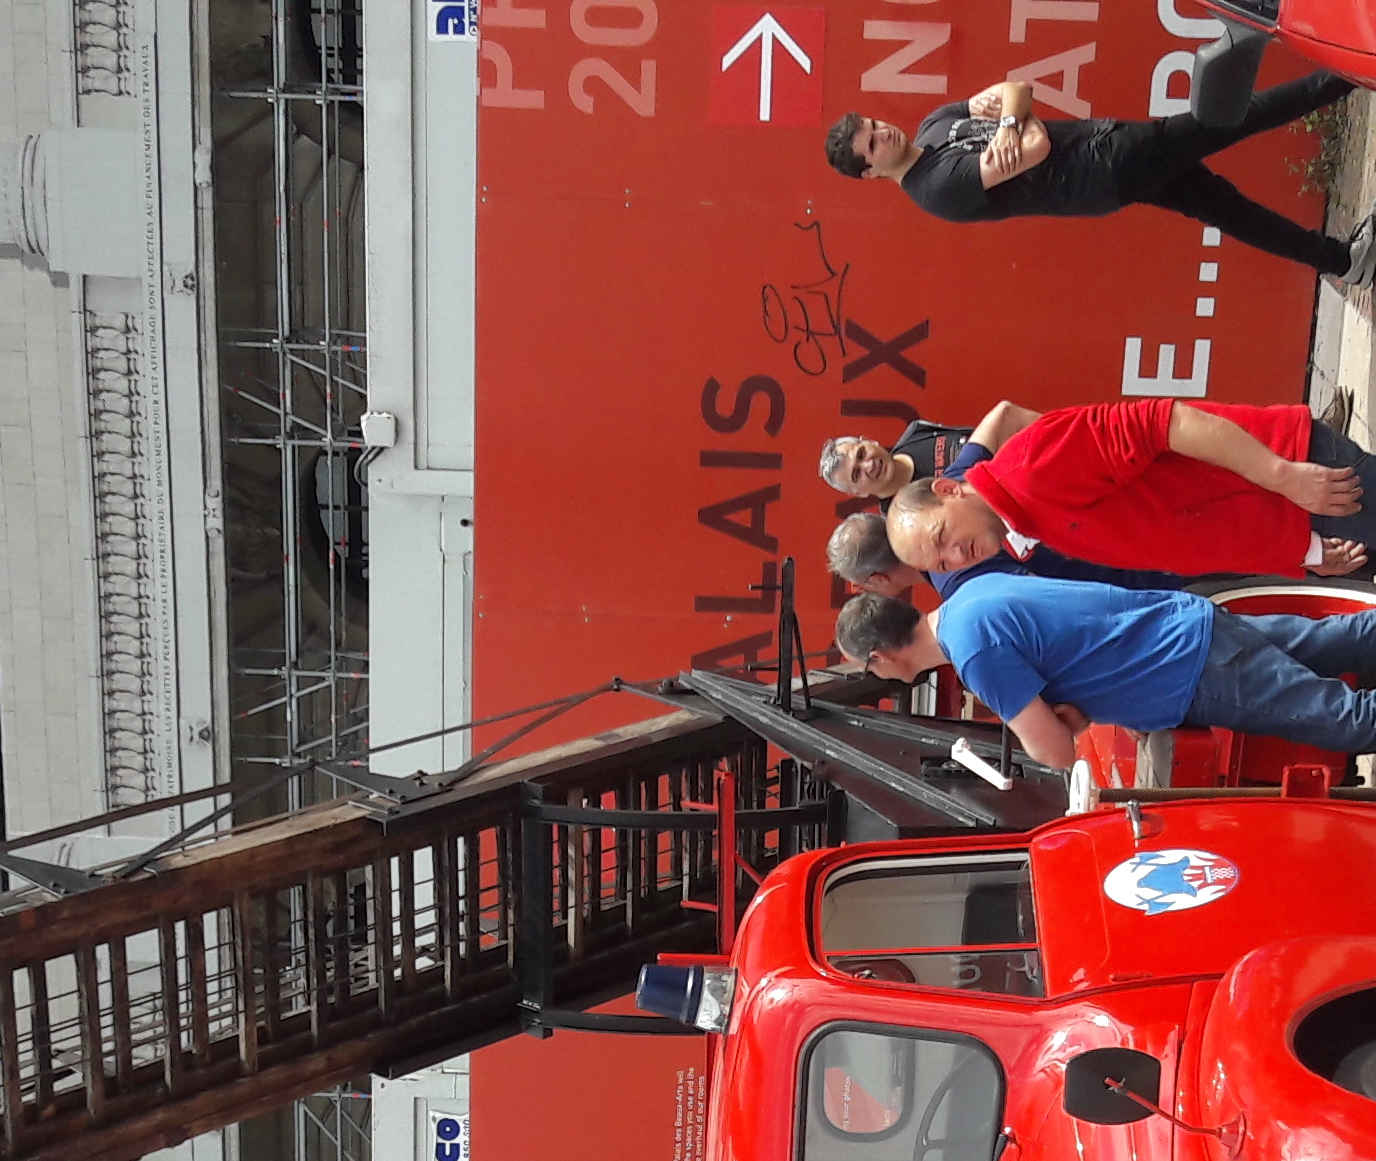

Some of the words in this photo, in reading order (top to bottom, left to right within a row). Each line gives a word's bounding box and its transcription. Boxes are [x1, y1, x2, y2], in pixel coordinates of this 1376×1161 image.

[432, 0, 466, 36] a
[860, 0, 952, 94] N
[140, 44, 151, 94] TRAVAUX
[142, 97, 151, 118] DES
[142, 122, 154, 199] FINANCEMENT
[144, 203, 154, 217] AU
[147, 283, 156, 310] SONT
[1120, 225, 1222, 398] E...
[148, 315, 158, 371] AFFICHAGE
[150, 375, 159, 395] CET
[152, 399, 161, 425] POUR
[152, 429, 164, 487] MONUMENT
[690, 374, 786, 685] ALAIS
[674, 1085, 684, 1127] Beaux-Arts
[673, 1128, 682, 1141] des
[685, 1126, 694, 1150] spaces
